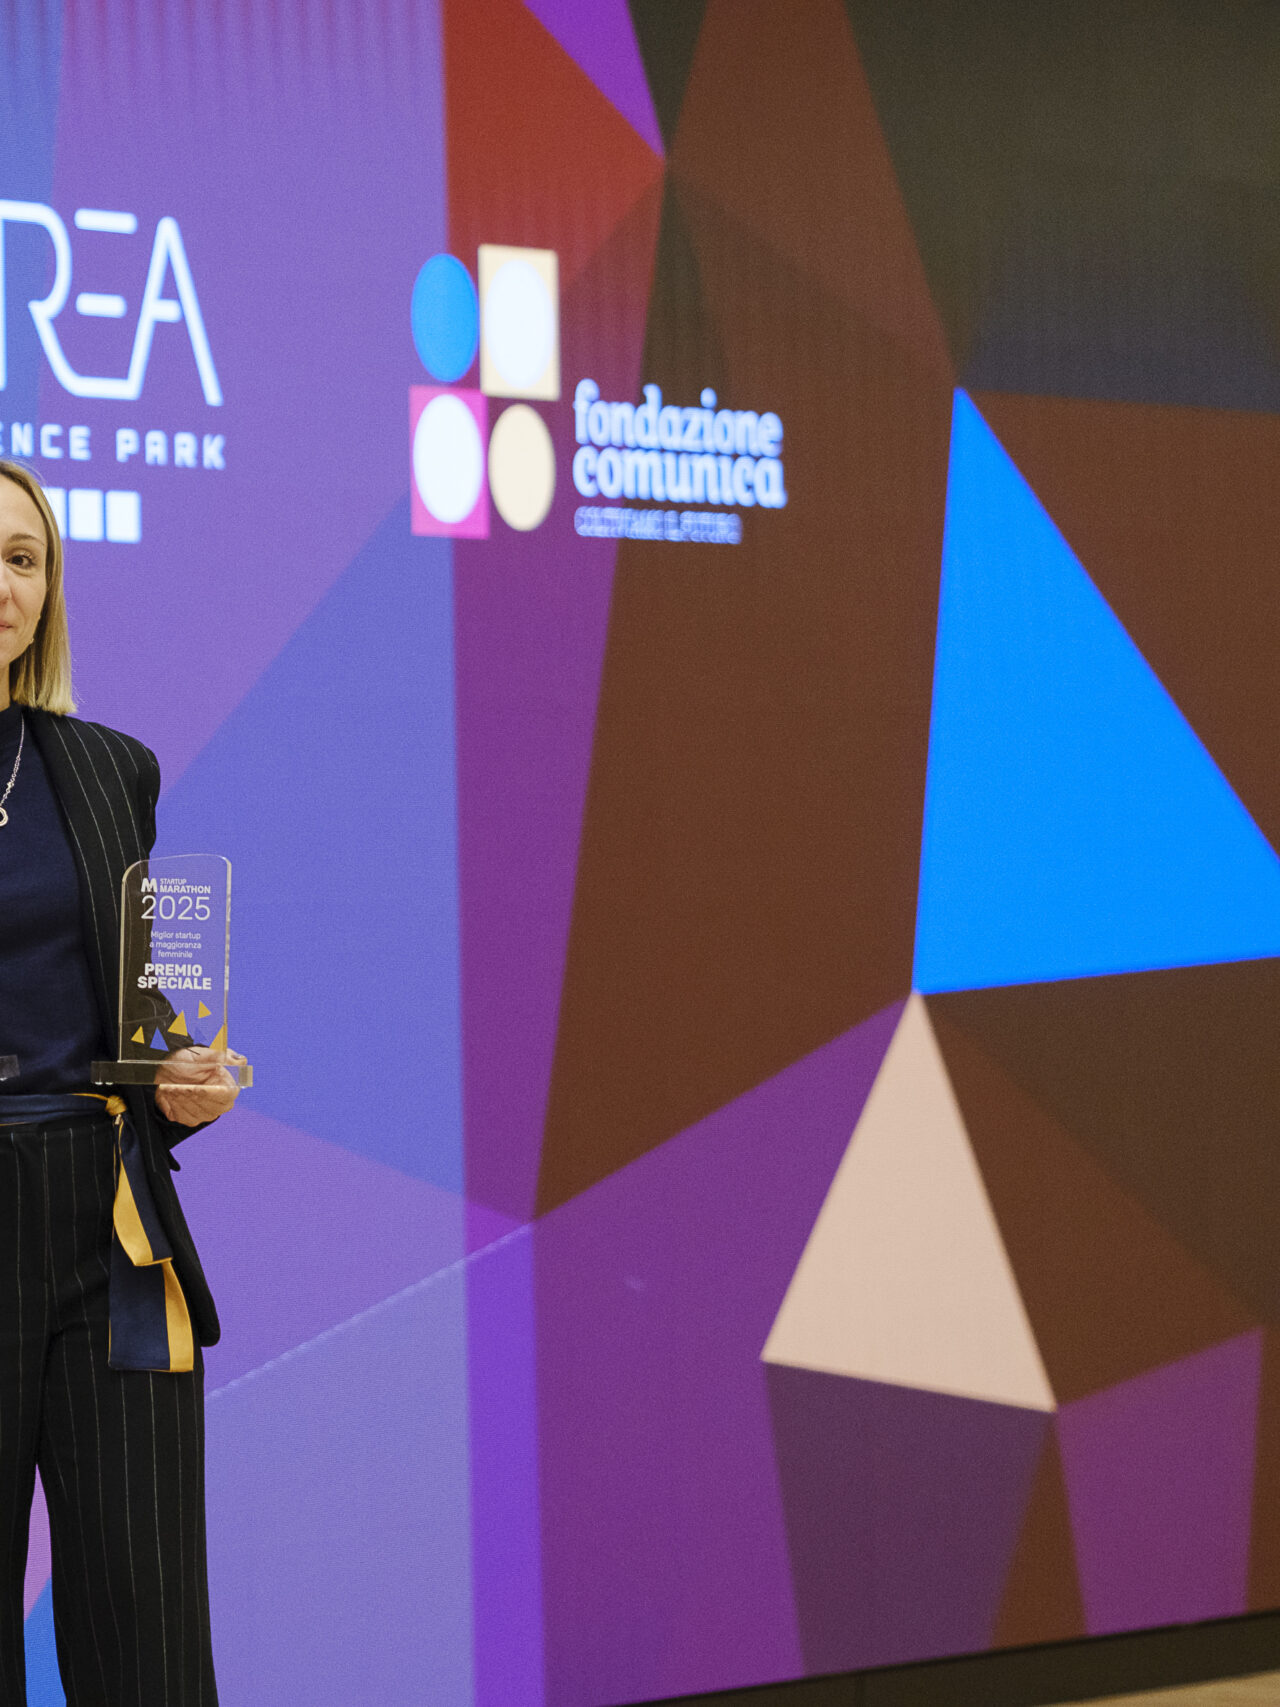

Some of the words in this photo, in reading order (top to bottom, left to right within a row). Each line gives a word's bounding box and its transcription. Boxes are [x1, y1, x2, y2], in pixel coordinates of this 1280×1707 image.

[573, 378, 783, 456] fondazione
[116, 428, 225, 470] PARK
[572, 445, 787, 508] comunica
[159, 884, 211, 894] MARATHON
[141, 895, 211, 921] 2025
[150, 930, 174, 940] Miglior
[175, 931, 201, 940] startup
[156, 941, 202, 950] maggioranza
[157, 950, 193, 959] femminile
[144, 963, 203, 977] PREMIO
[137, 976, 212, 990] SPECIALE
